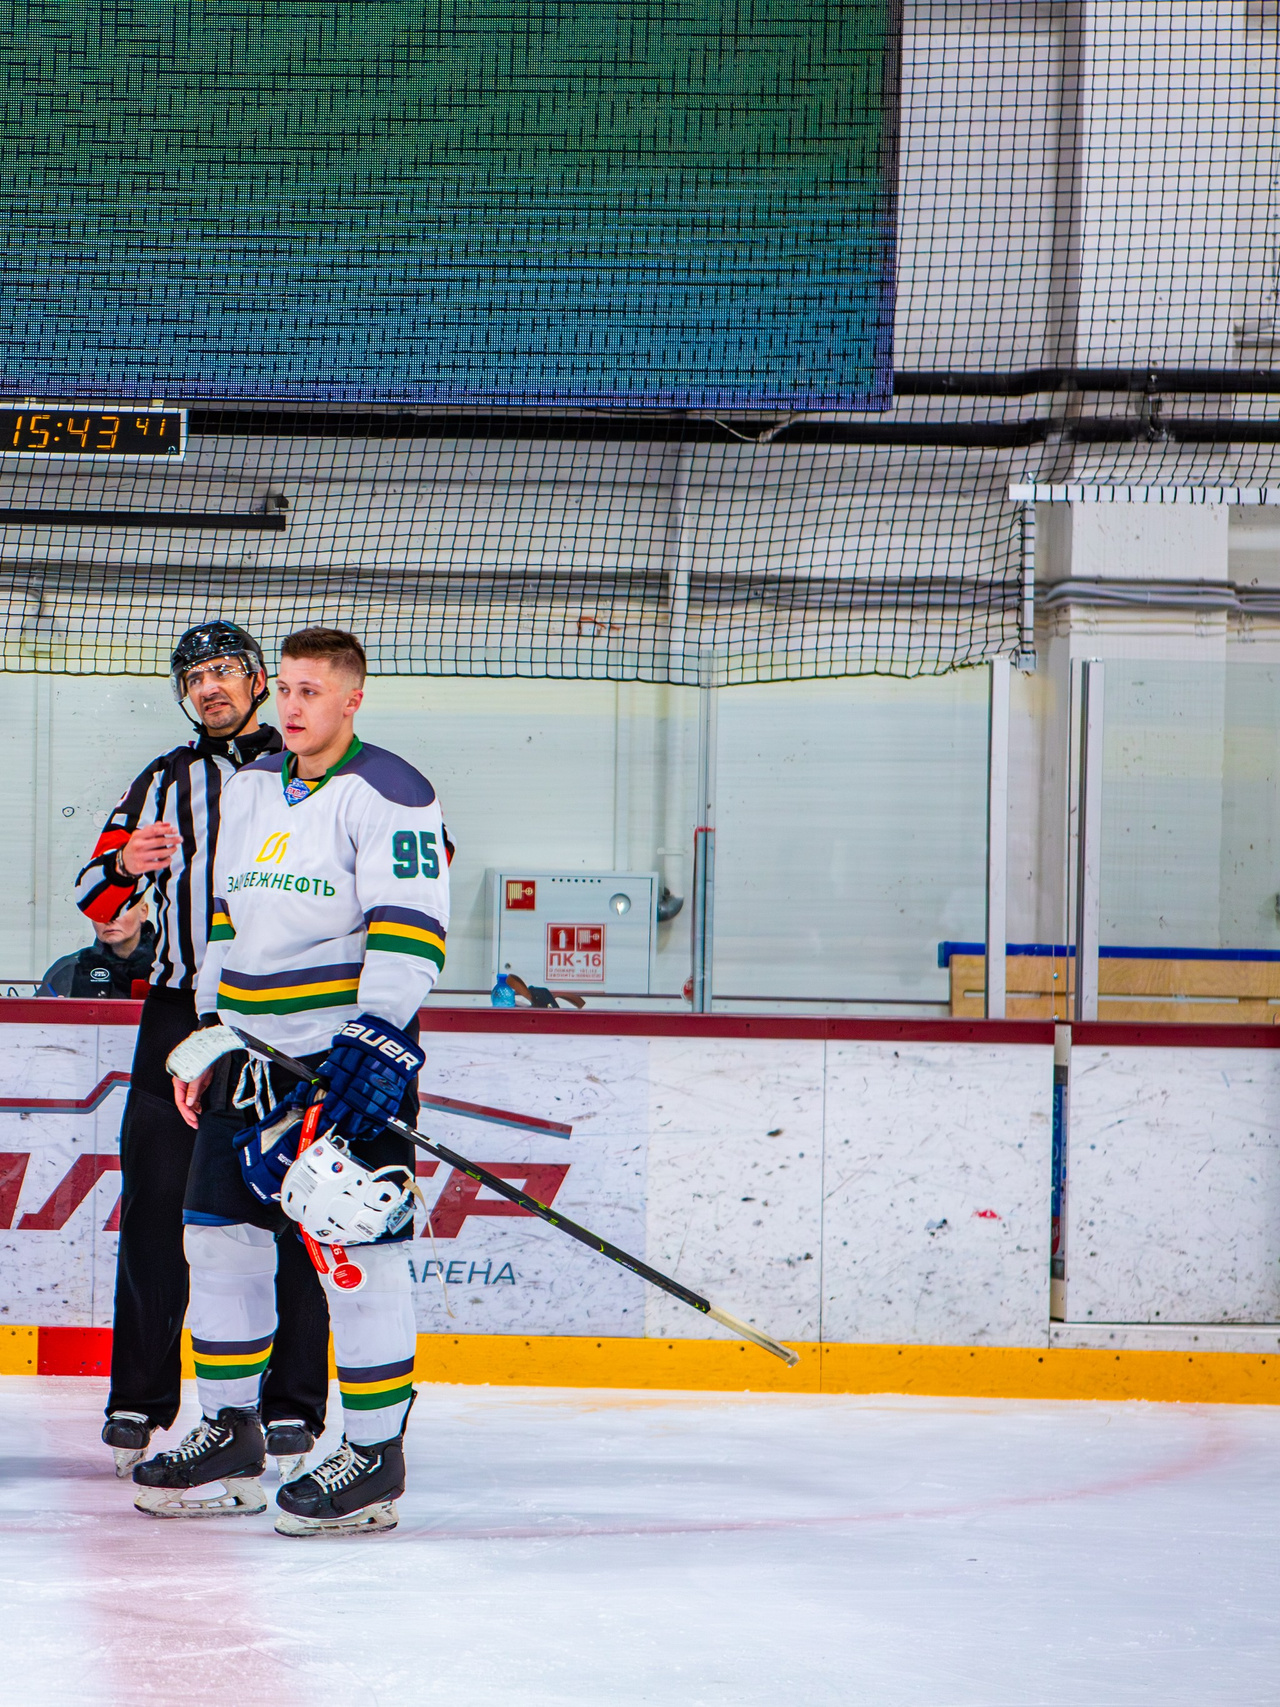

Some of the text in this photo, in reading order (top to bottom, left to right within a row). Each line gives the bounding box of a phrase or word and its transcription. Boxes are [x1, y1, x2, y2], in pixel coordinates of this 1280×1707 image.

[13, 414, 166, 449] 15:43 41
[392, 830, 440, 879] 95
[549, 952, 602, 968] ПК-16
[335, 1021, 420, 1072] BAUER
